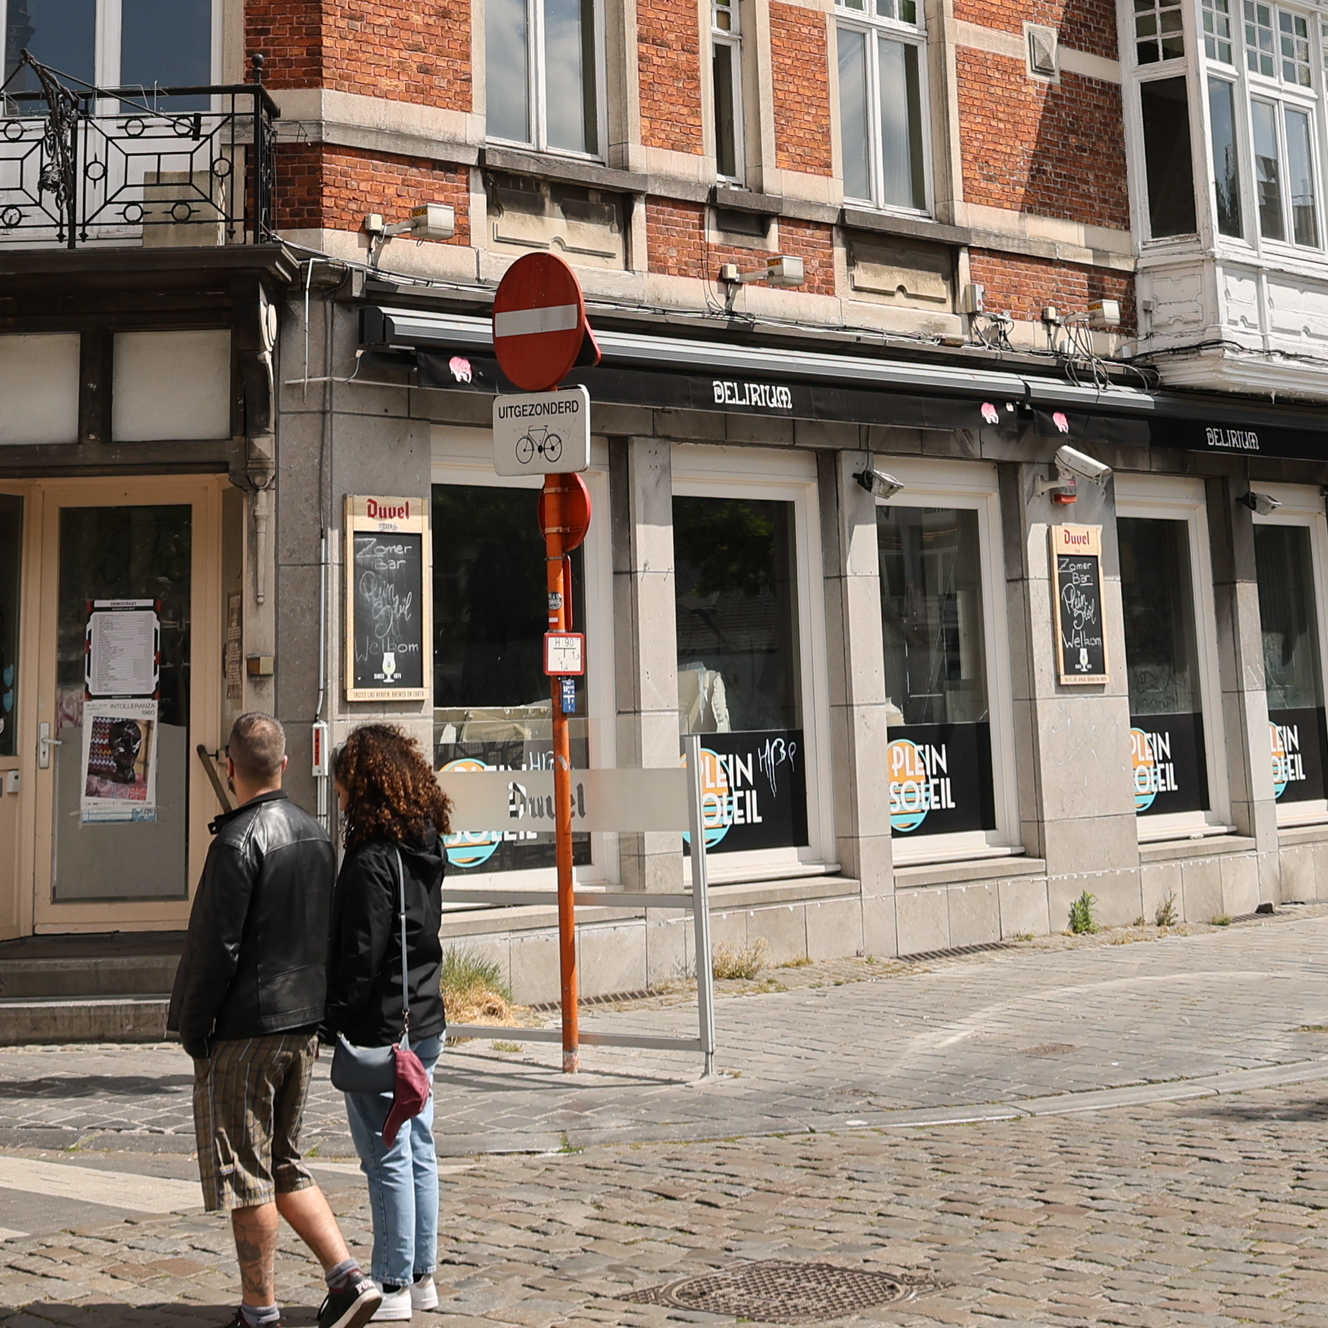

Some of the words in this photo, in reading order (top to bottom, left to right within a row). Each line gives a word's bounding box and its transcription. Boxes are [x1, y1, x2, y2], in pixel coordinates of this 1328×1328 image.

[712, 380, 792, 409] DELIRIUM
[498, 399, 580, 419] UITGEZONDERD
[1205, 427, 1260, 450] DELIRIUM
[367, 498, 409, 520] Duvel
[355, 537, 413, 559] Zomer
[1064, 529, 1091, 545] Duvel
[374, 558, 407, 570] Bar
[1058, 558, 1092, 572] Zomer
[1071, 573, 1093, 585] Bar
[1062, 629, 1102, 649] Welkom
[1270, 725, 1300, 753] LEIN
[700, 753, 754, 788] LEIN
[891, 744, 948, 777] PLEIN
[1272, 754, 1306, 782] OLEIL
[1135, 763, 1179, 792] OLEIL
[508, 782, 586, 820] Duvl
[889, 777, 956, 812] SOLEIL
[702, 790, 763, 825] OLEIL
